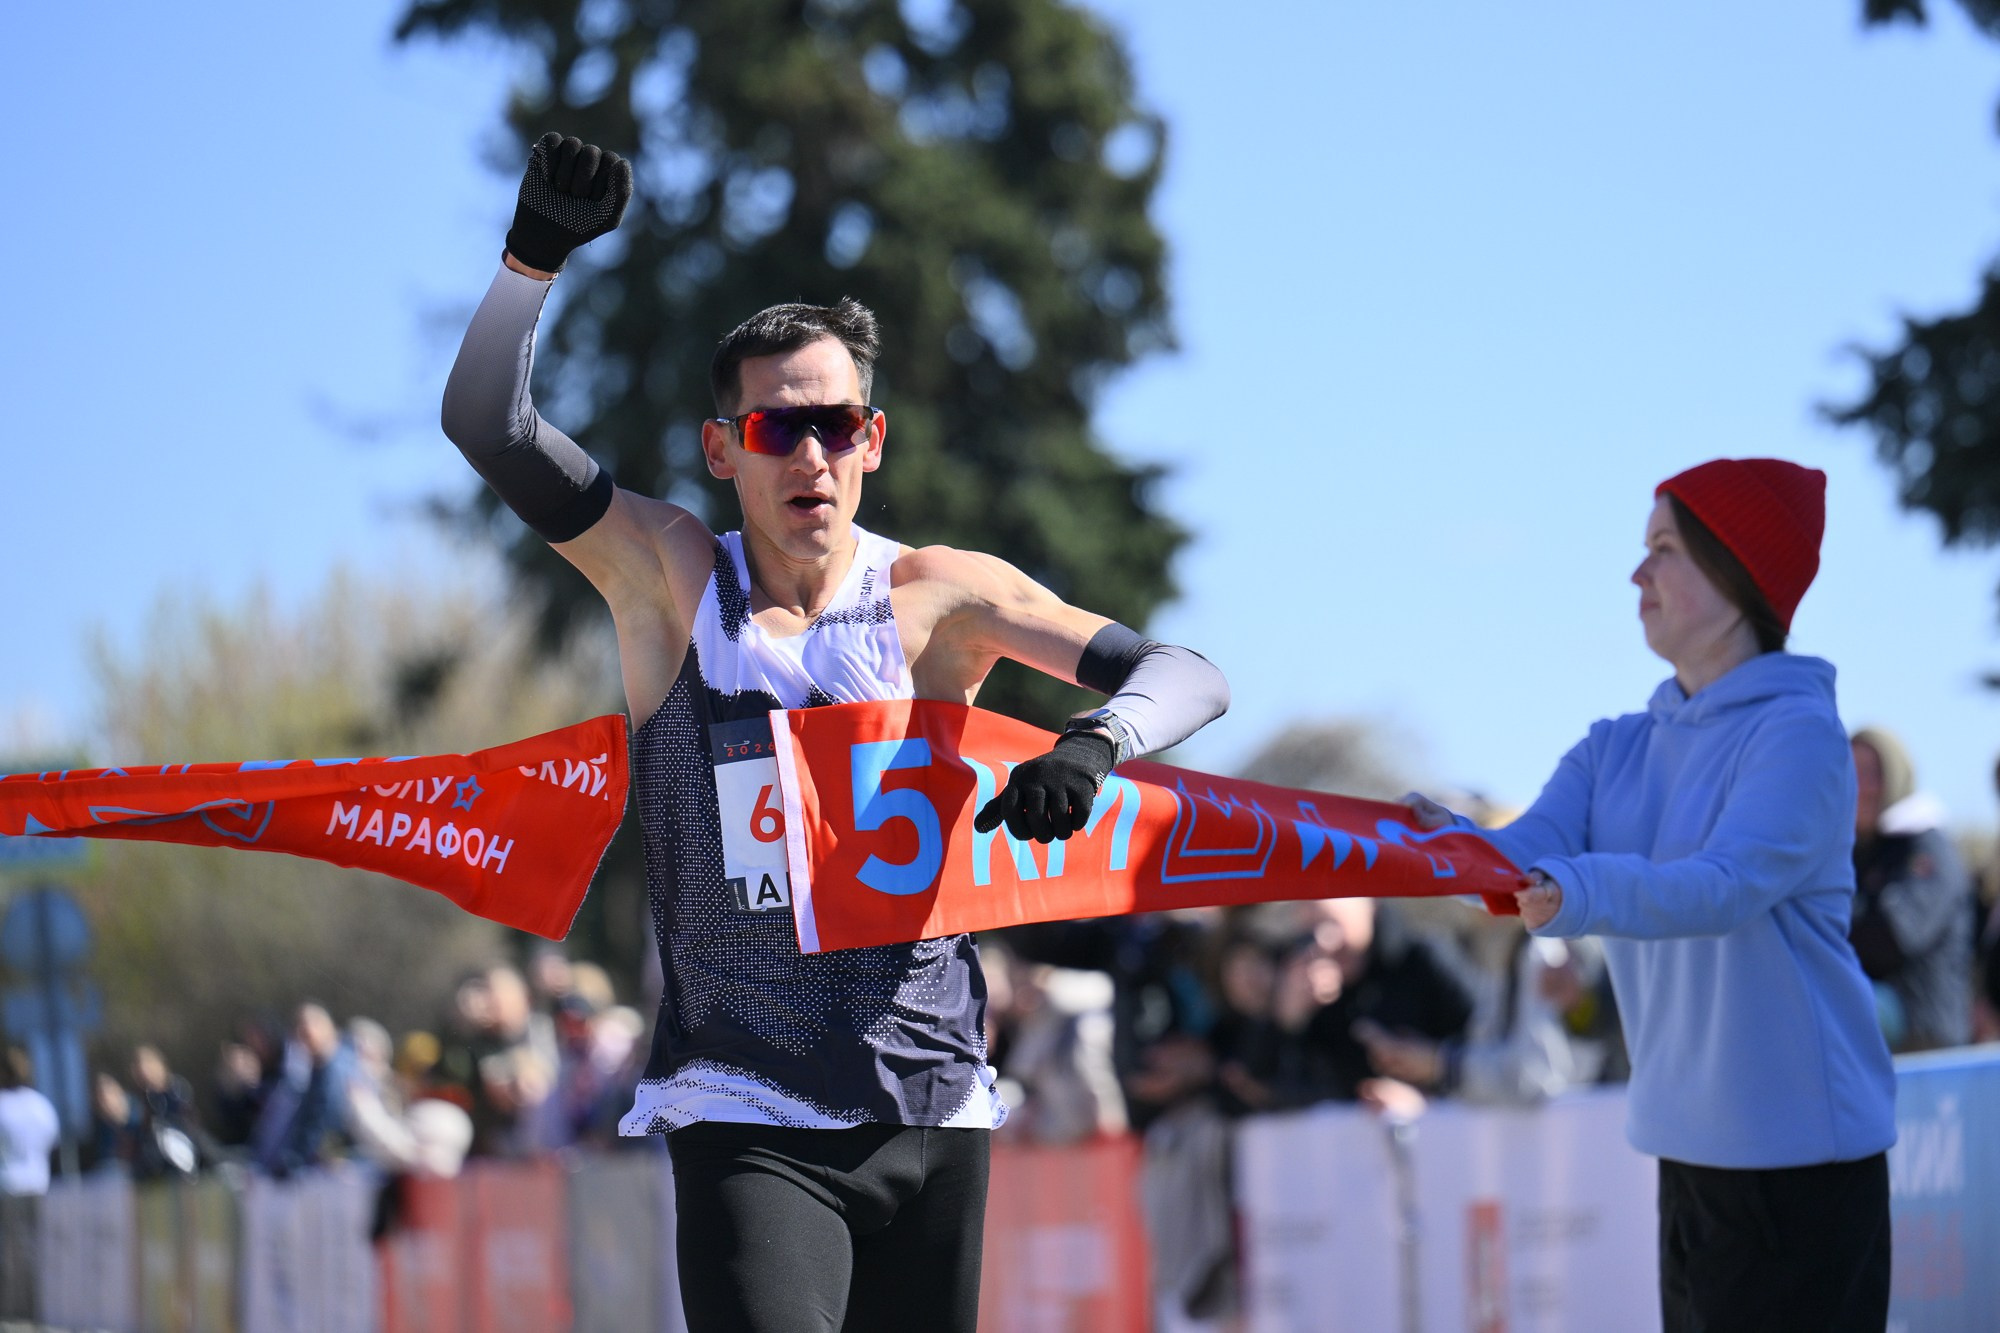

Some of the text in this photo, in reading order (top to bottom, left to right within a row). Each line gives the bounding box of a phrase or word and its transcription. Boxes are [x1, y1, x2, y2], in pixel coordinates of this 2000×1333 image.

[726, 742, 775, 757] 2026
[359, 775, 455, 804] ЛУ
[749, 784, 785, 843] 6
[850, 737, 943, 895] 5
[325, 801, 514, 874] МАРАФОН
